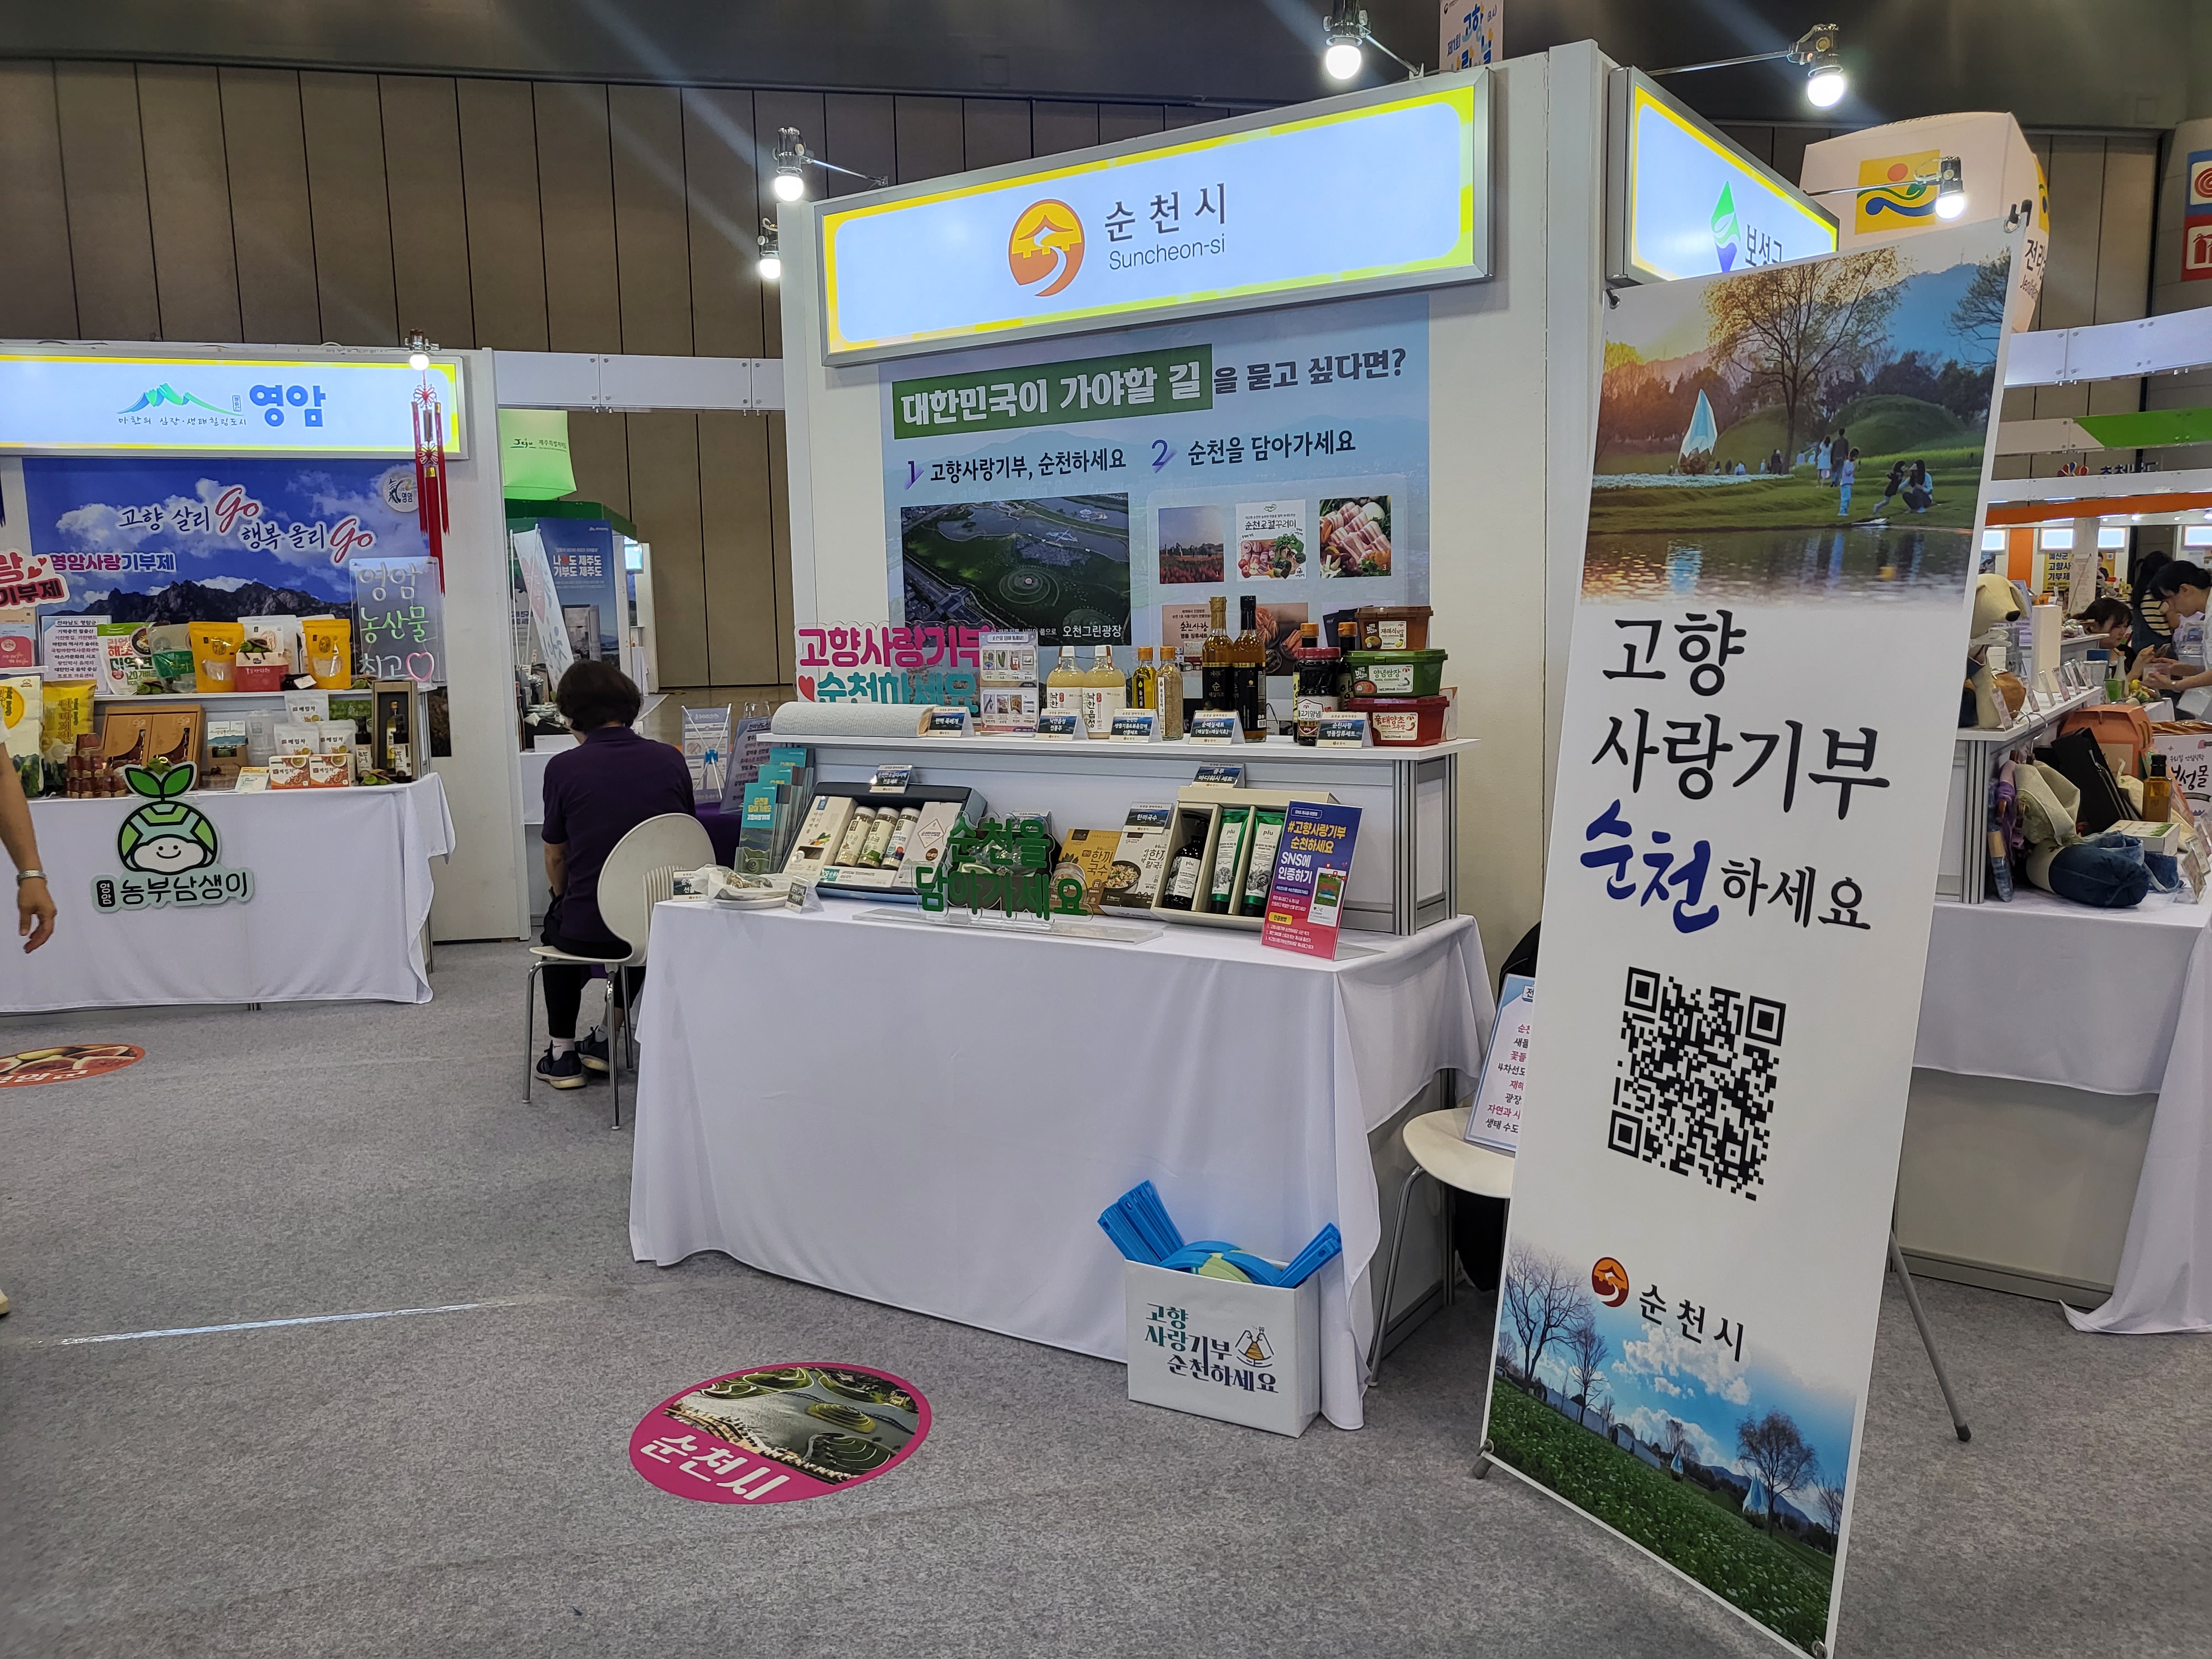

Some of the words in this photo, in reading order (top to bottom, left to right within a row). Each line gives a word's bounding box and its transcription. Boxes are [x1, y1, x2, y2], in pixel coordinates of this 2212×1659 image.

[1105, 182, 1225, 242] 순천시
[1109, 233, 1225, 270] Suncheon-si
[901, 377, 1049, 426] 대한민국이
[1059, 369, 1157, 409] 가야할
[1169, 361, 1201, 399] 길
[1214, 367, 1239, 394] 을
[1247, 359, 1298, 392] 묻고
[1307, 347, 1407, 388] 싶다면?
[249, 384, 326, 427] 영암
[930, 456, 1033, 485] 고향사랑기부,
[1037, 447, 1127, 478] 순천하세요
[1187, 438, 1245, 467] 순천을
[1251, 429, 1356, 462] 담아가세요
[118, 505, 164, 531] 고향
[241, 525, 281, 551] 행복
[554, 566, 578, 577] 기부도
[579, 566, 603, 577] 제주도
[578, 555, 602, 566] 제주도
[358, 561, 423, 602] 영암
[361, 606, 429, 643] 농산물
[1039, 628, 1057, 636] 품으로
[1062, 624, 1123, 638] 오천그린광장
[1180, 620, 1209, 632] 순천사랑
[798, 625, 990, 667] 고향사랑기부
[1602, 609, 1747, 696] 고향
[1373, 668, 1401, 679] 양념쌈장
[1591, 708, 1890, 820] 사랑기부
[947, 816, 1051, 868] 순천을
[1287, 820, 1347, 839] #고향사랑기부
[1290, 836, 1334, 854] 순천하세요
[1087, 863, 1108, 877] 국수
[1091, 851, 1114, 863] 한끼
[1278, 866, 1313, 884] 인증하기
[1281, 852, 1312, 868] SNS에
[1580, 799, 1871, 934] 순천하세요
[119, 871, 248, 905] 농부남생이
[915, 867, 1088, 921] 담아가세요
[1485, 1117, 1502, 1130] 생태
[1486, 1104, 1512, 1118] 자연과
[1145, 1302, 1190, 1330] 고향
[1639, 1283, 1744, 1363] 순천시
[1144, 1324, 1233, 1365] 사랑기부
[1167, 1353, 1279, 1394] 순천하세요
[639, 1434, 791, 1500] 순천시
